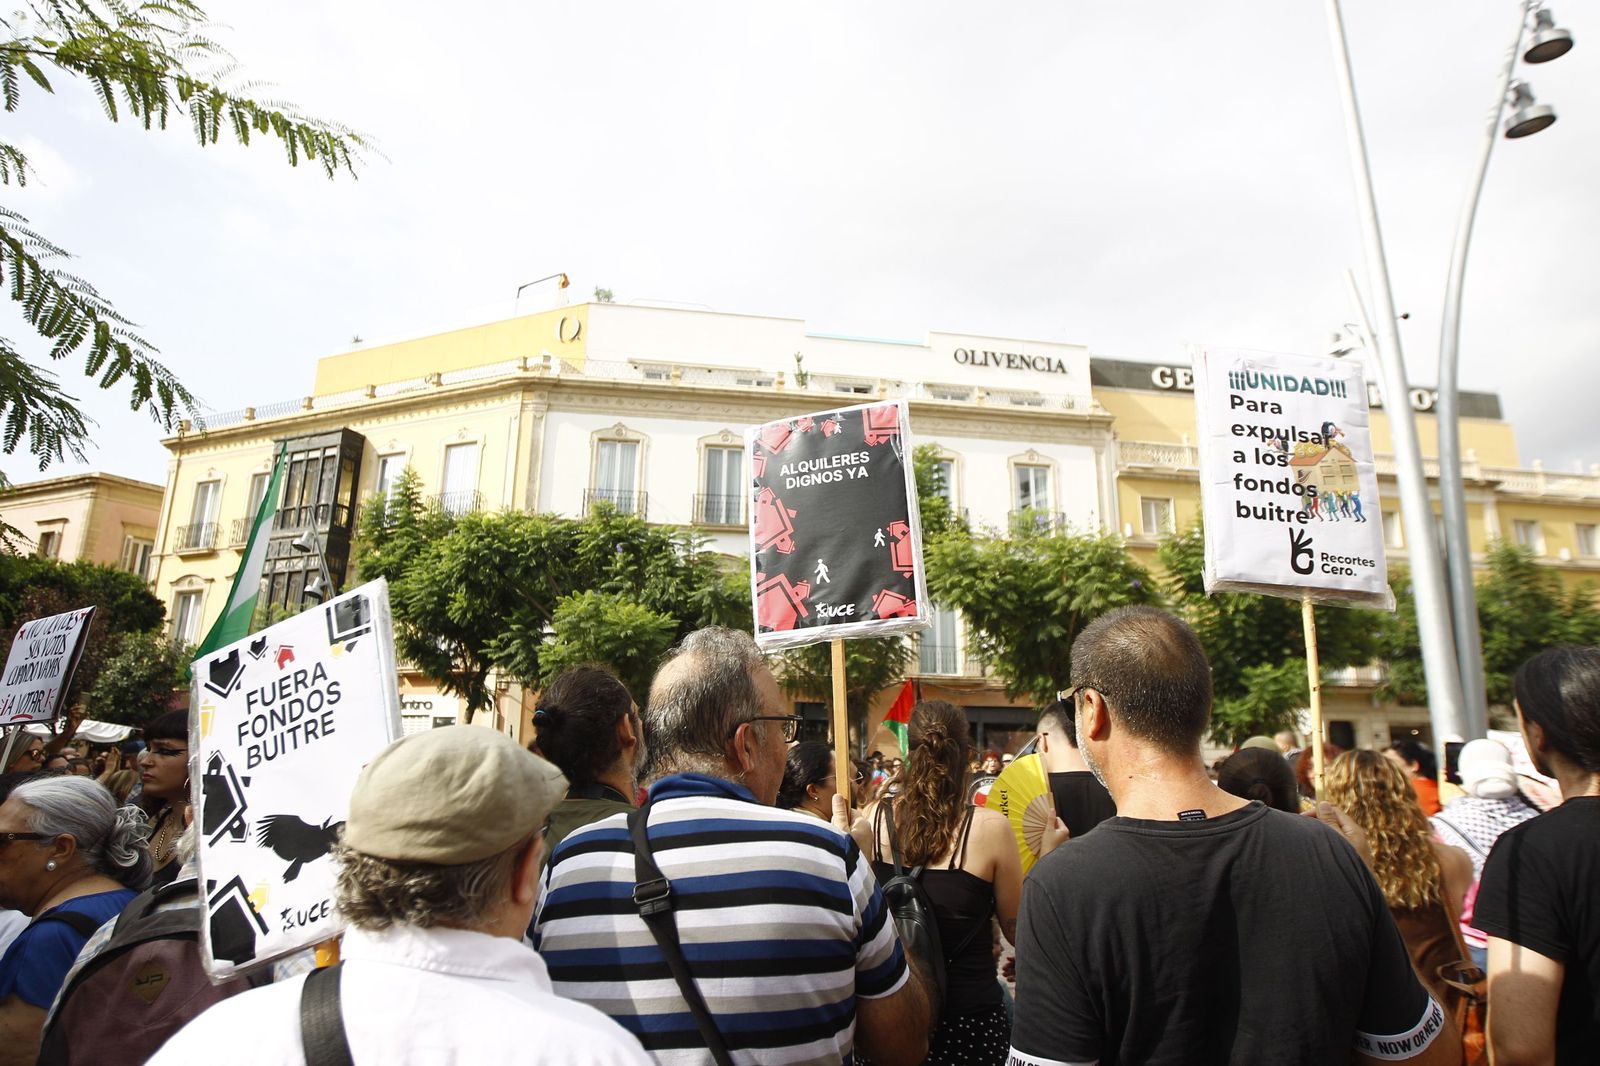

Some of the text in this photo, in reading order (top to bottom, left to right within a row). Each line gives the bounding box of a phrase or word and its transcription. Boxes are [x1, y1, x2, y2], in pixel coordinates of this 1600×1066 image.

[953, 347, 1068, 375] OLIVENCIA
[1228, 369, 1348, 399] ¡¡¡UNIDAD!!!
[1230, 394, 1283, 415] Para
[1231, 422, 1331, 447] expulsar
[779, 451, 871, 477] ALQUILERES
[1232, 447, 1289, 467] a los
[786, 465, 869, 490] DIGNOS YA
[1233, 473, 1318, 498] fondos
[1236, 500, 1309, 525] buitre
[1320, 552, 1376, 568] Recortes
[1321, 562, 1358, 577] Cero.
[246, 661, 328, 715] FUERA
[237, 680, 342, 747] FONDOS
[246, 710, 336, 770] BUITRE
[1377, 1039, 1412, 1056] NOW
[1413, 1032, 1428, 1048] OR
